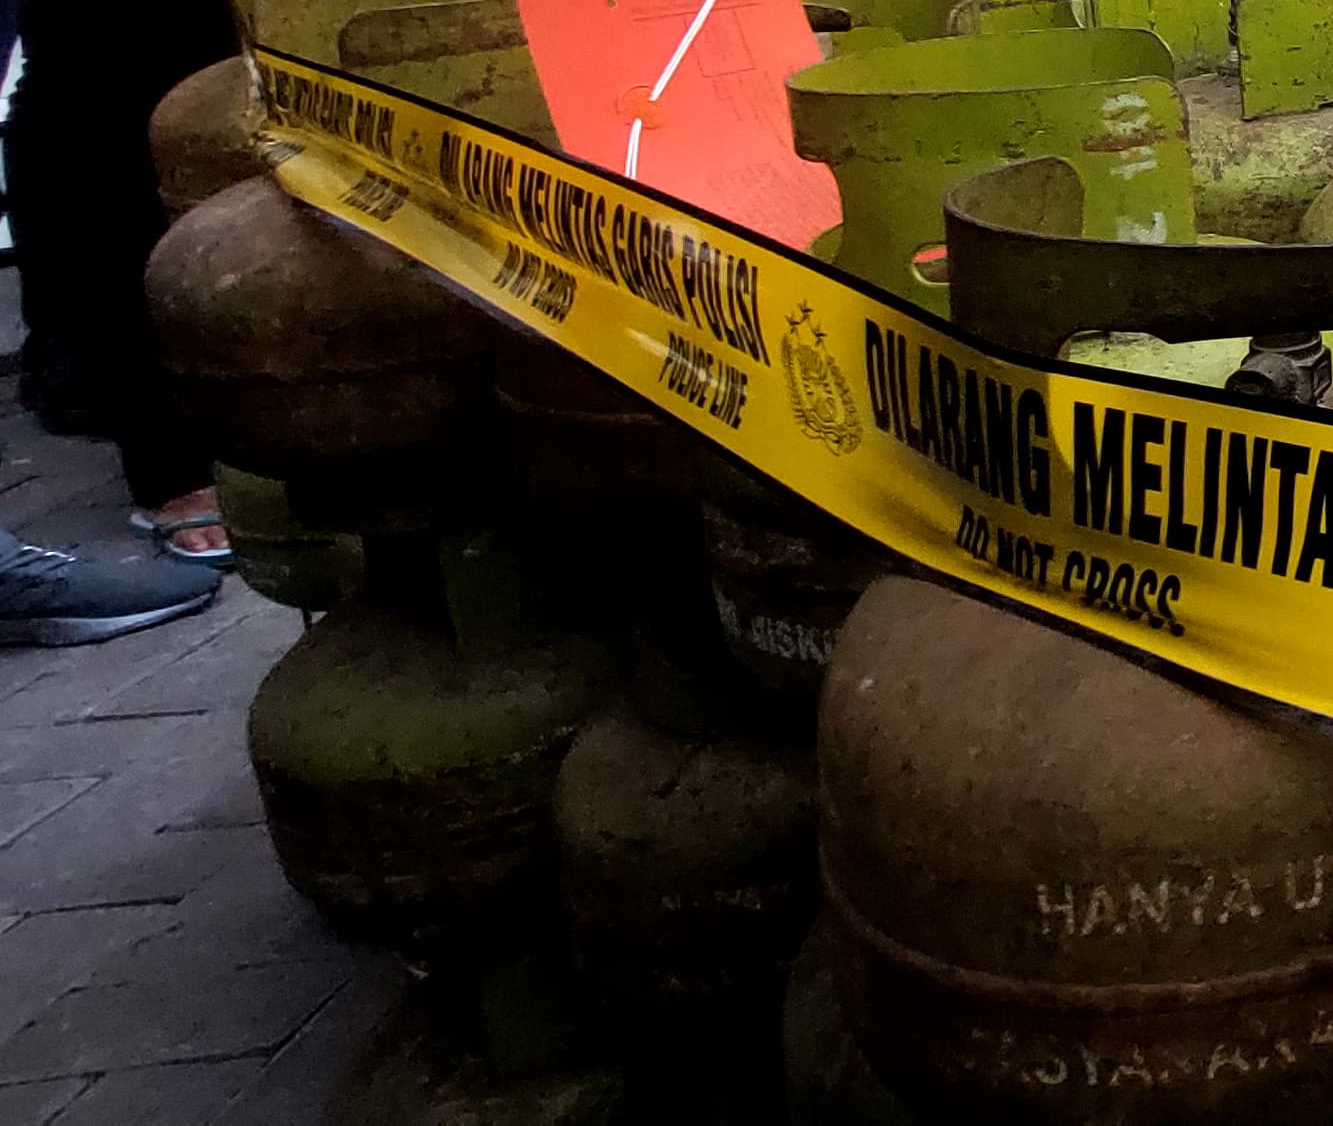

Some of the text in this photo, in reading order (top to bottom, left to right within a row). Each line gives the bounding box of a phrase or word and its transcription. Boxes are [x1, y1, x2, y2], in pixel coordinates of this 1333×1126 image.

[518, 165, 618, 285] MELINTAS
[612, 202, 688, 323] GARIS
[682, 234, 771, 368] POLISI
[658, 331, 749, 430] POLICE LINE
[864, 317, 1052, 517] DILARANG
[956, 504, 1186, 637] DO NOT CROSS
